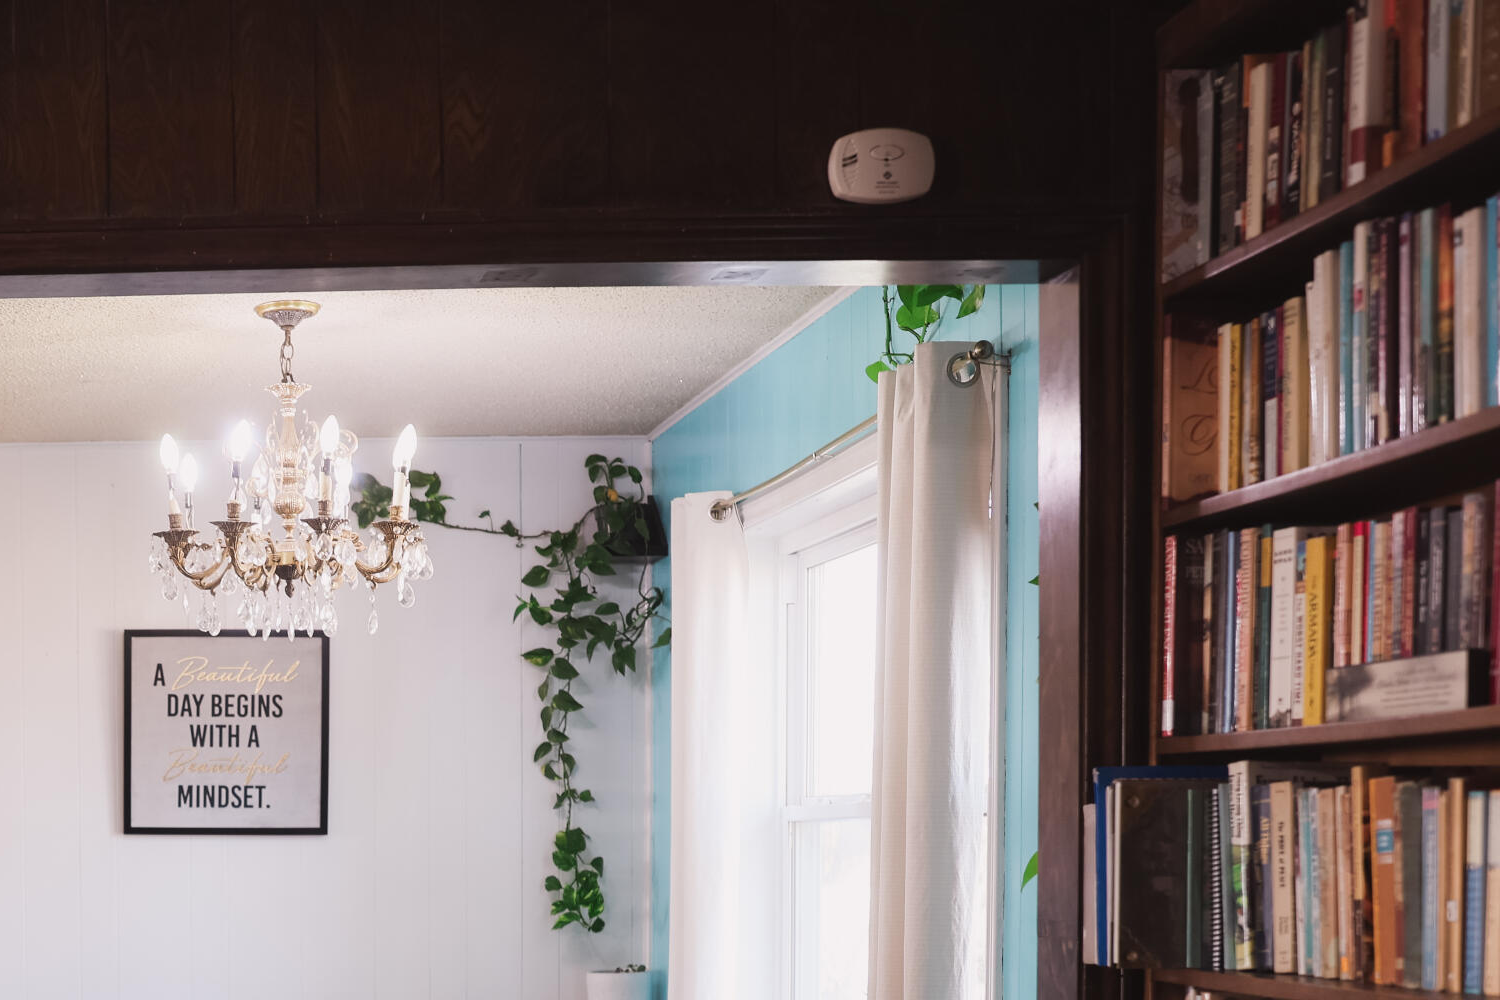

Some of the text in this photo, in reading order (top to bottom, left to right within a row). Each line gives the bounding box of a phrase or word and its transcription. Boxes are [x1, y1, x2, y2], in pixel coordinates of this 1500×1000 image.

[1307, 593, 1318, 660] ARMADA
[153, 656, 301, 694] A Beautiful
[167, 694, 283, 718] DAY BEGINS
[1294, 683, 1303, 705] TIME
[190, 724, 260, 748] WITH A
[162, 749, 291, 785] Beautiful
[177, 785, 271, 808] MINDSET.
